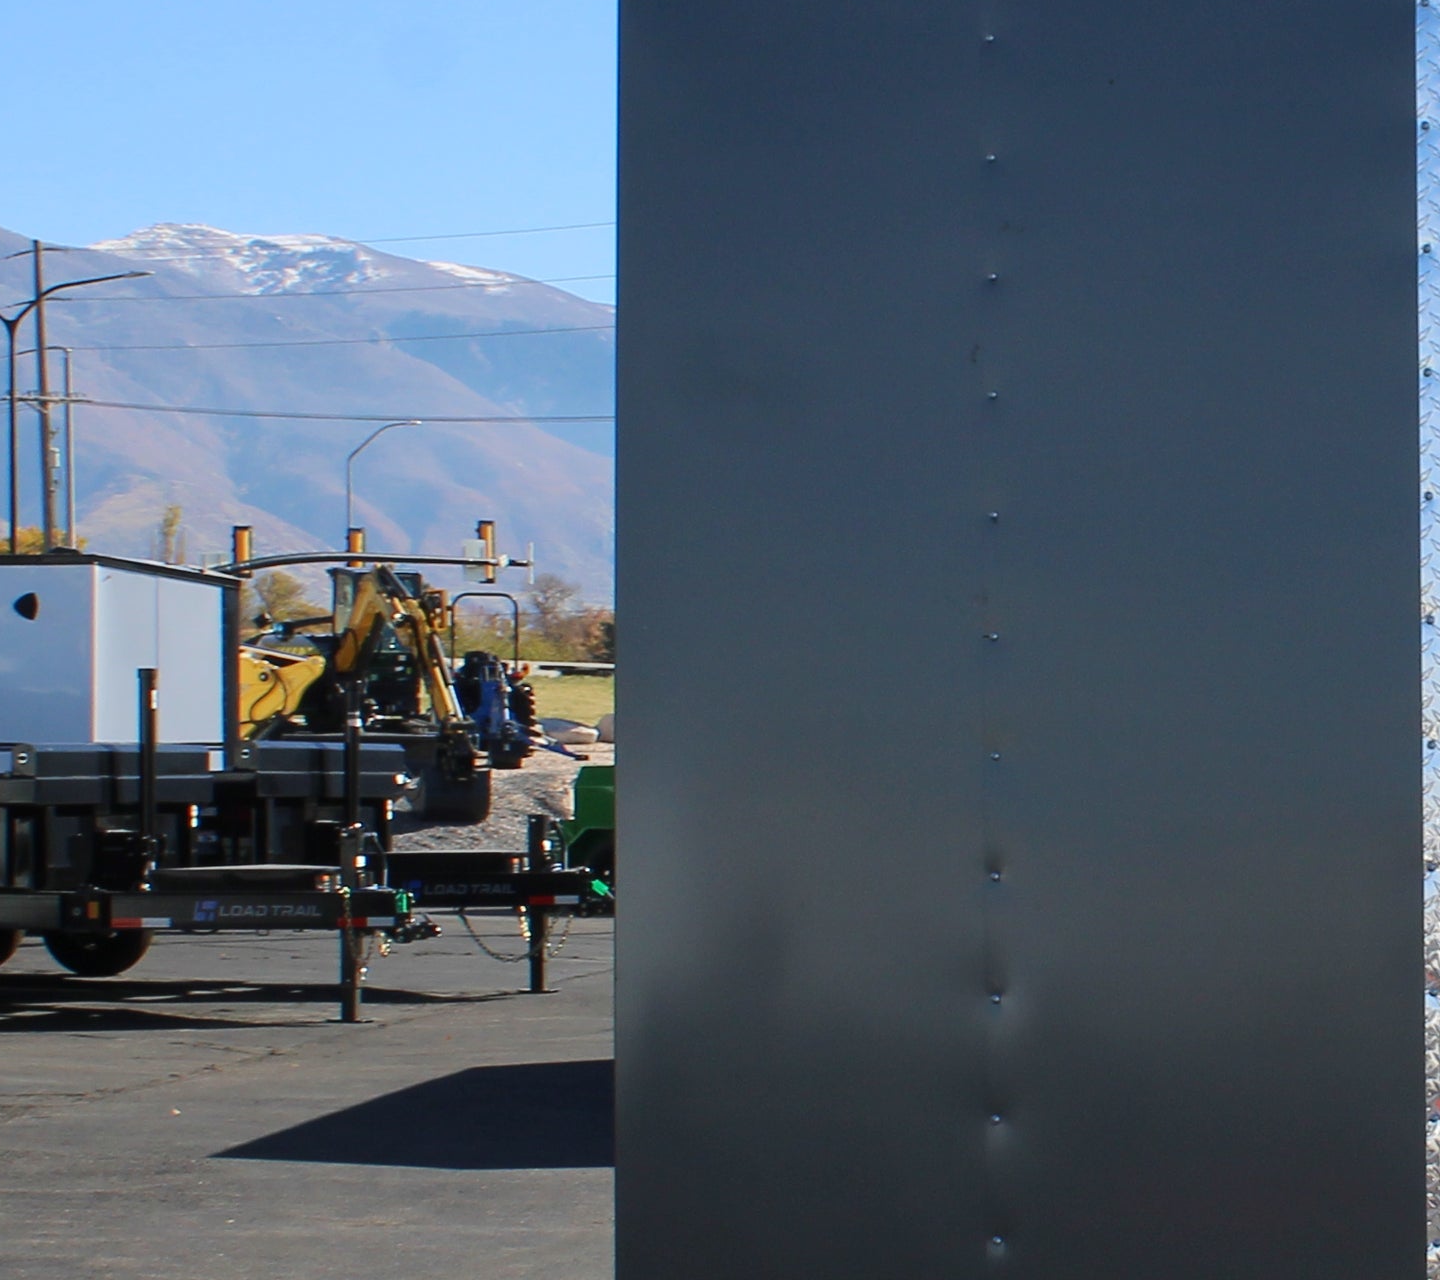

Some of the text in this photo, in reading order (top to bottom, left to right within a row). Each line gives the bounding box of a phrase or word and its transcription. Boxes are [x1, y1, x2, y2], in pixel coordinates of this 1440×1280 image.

[424, 883, 517, 895] LOAD TRAIL
[219, 904, 323, 917] LOAD TRAIL
